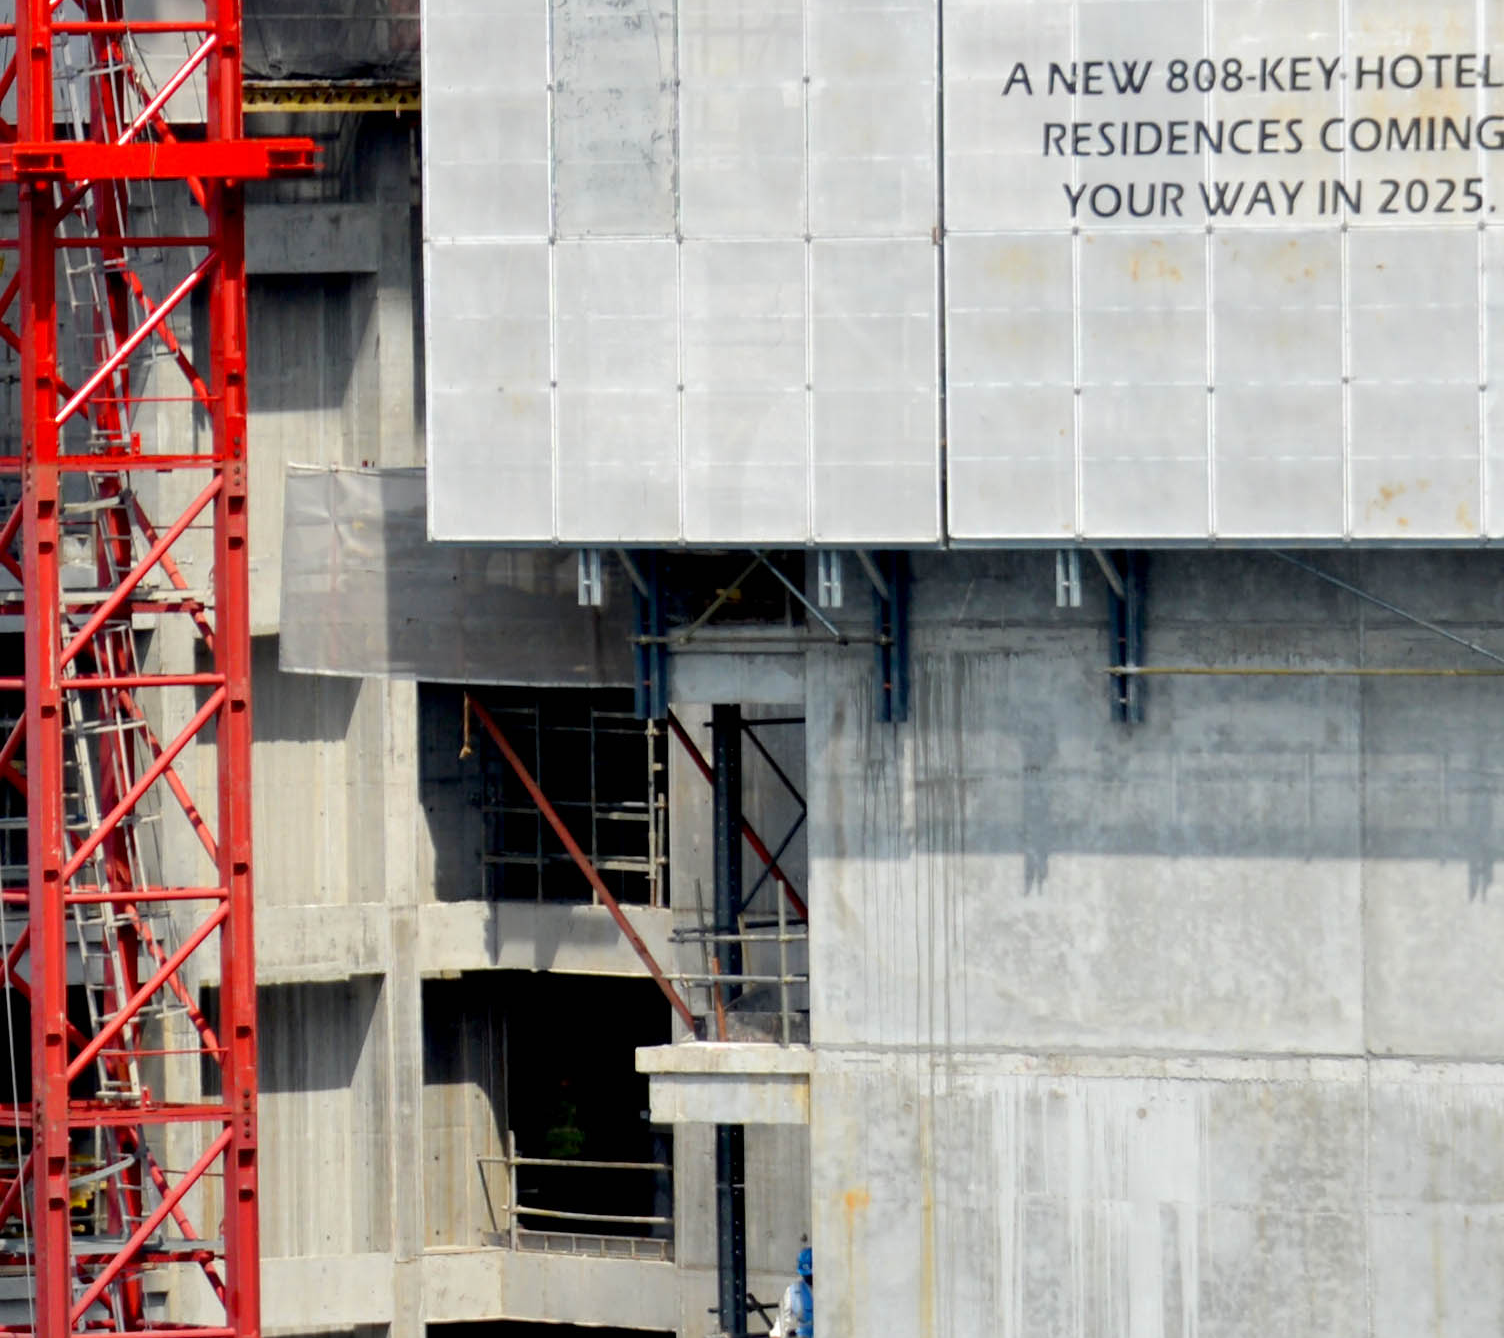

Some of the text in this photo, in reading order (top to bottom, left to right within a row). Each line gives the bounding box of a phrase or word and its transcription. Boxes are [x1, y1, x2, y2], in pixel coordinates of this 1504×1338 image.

[1002, 62, 1033, 96] A
[1048, 60, 1153, 96] NEW
[1166, 56, 1342, 93] 808-KEY
[1355, 54, 1504, 90] HOTEL
[1043, 118, 1304, 157] RESIDENCES
[1062, 178, 1497, 217] YOUR WAY IN 2025.
